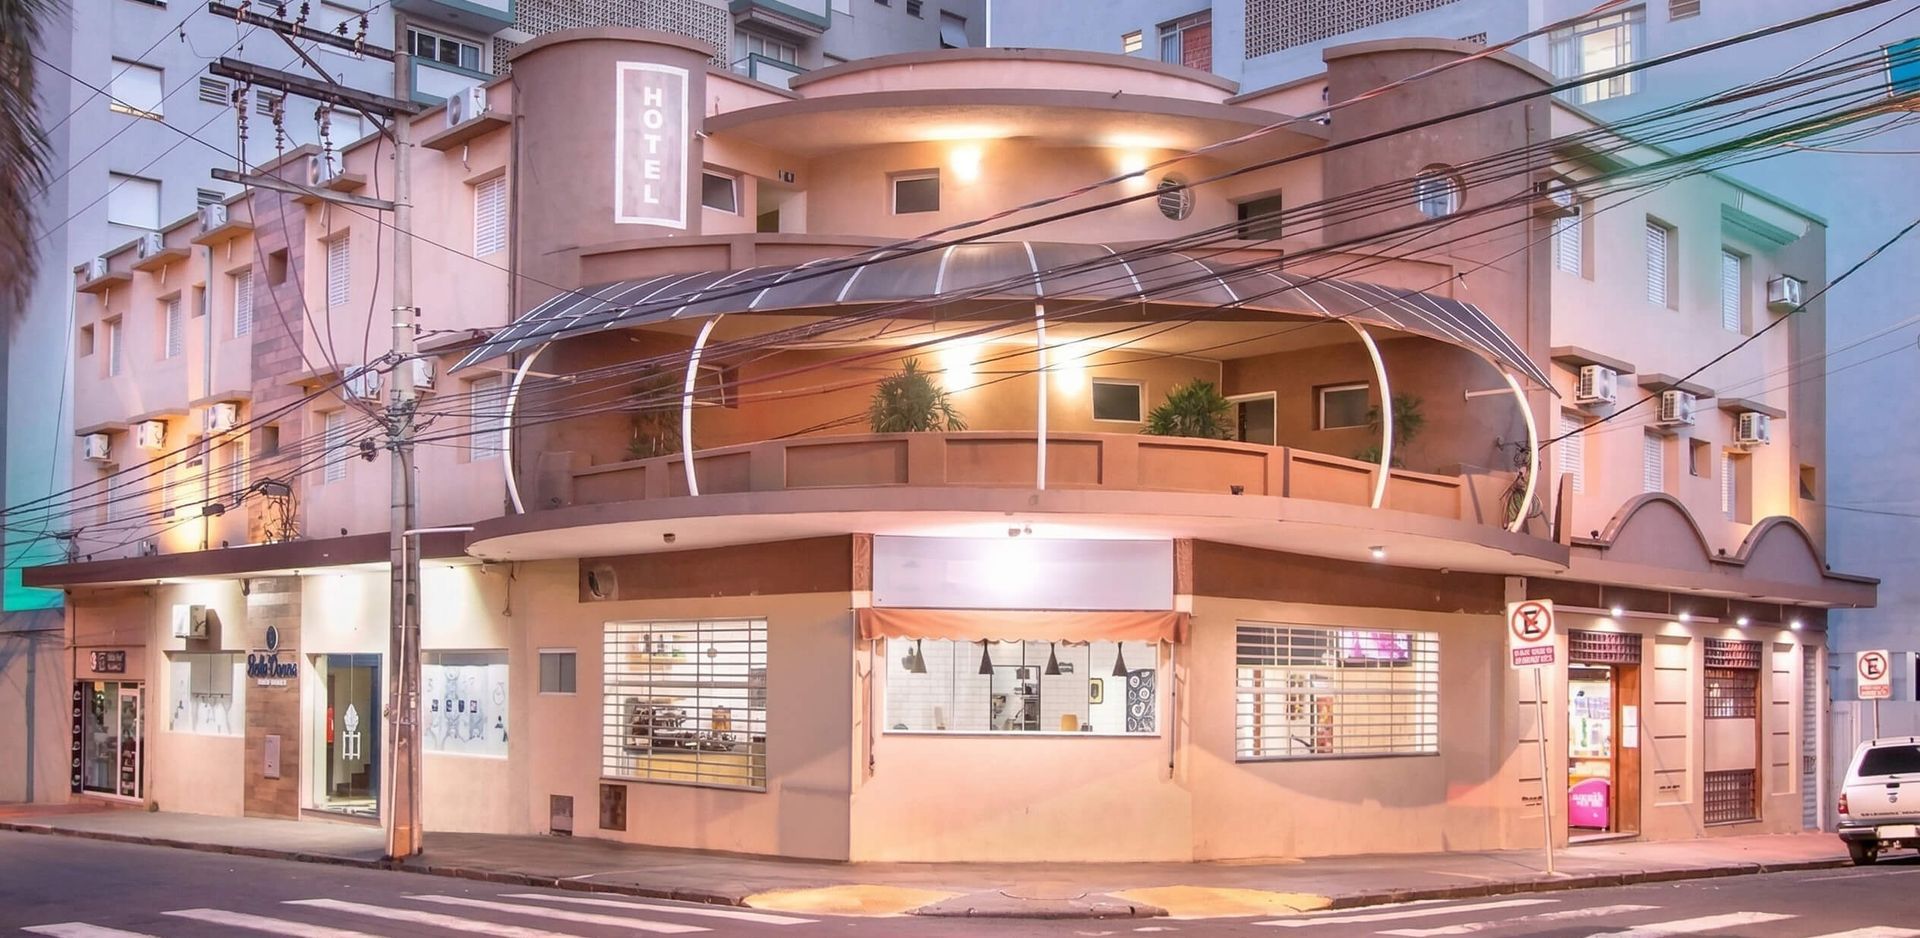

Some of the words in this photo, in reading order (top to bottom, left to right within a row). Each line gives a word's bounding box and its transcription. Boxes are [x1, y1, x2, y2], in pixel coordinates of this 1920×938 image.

[643, 86, 663, 204] HOTEL
[1524, 610, 1540, 634] E
[1867, 657, 1878, 675] E
